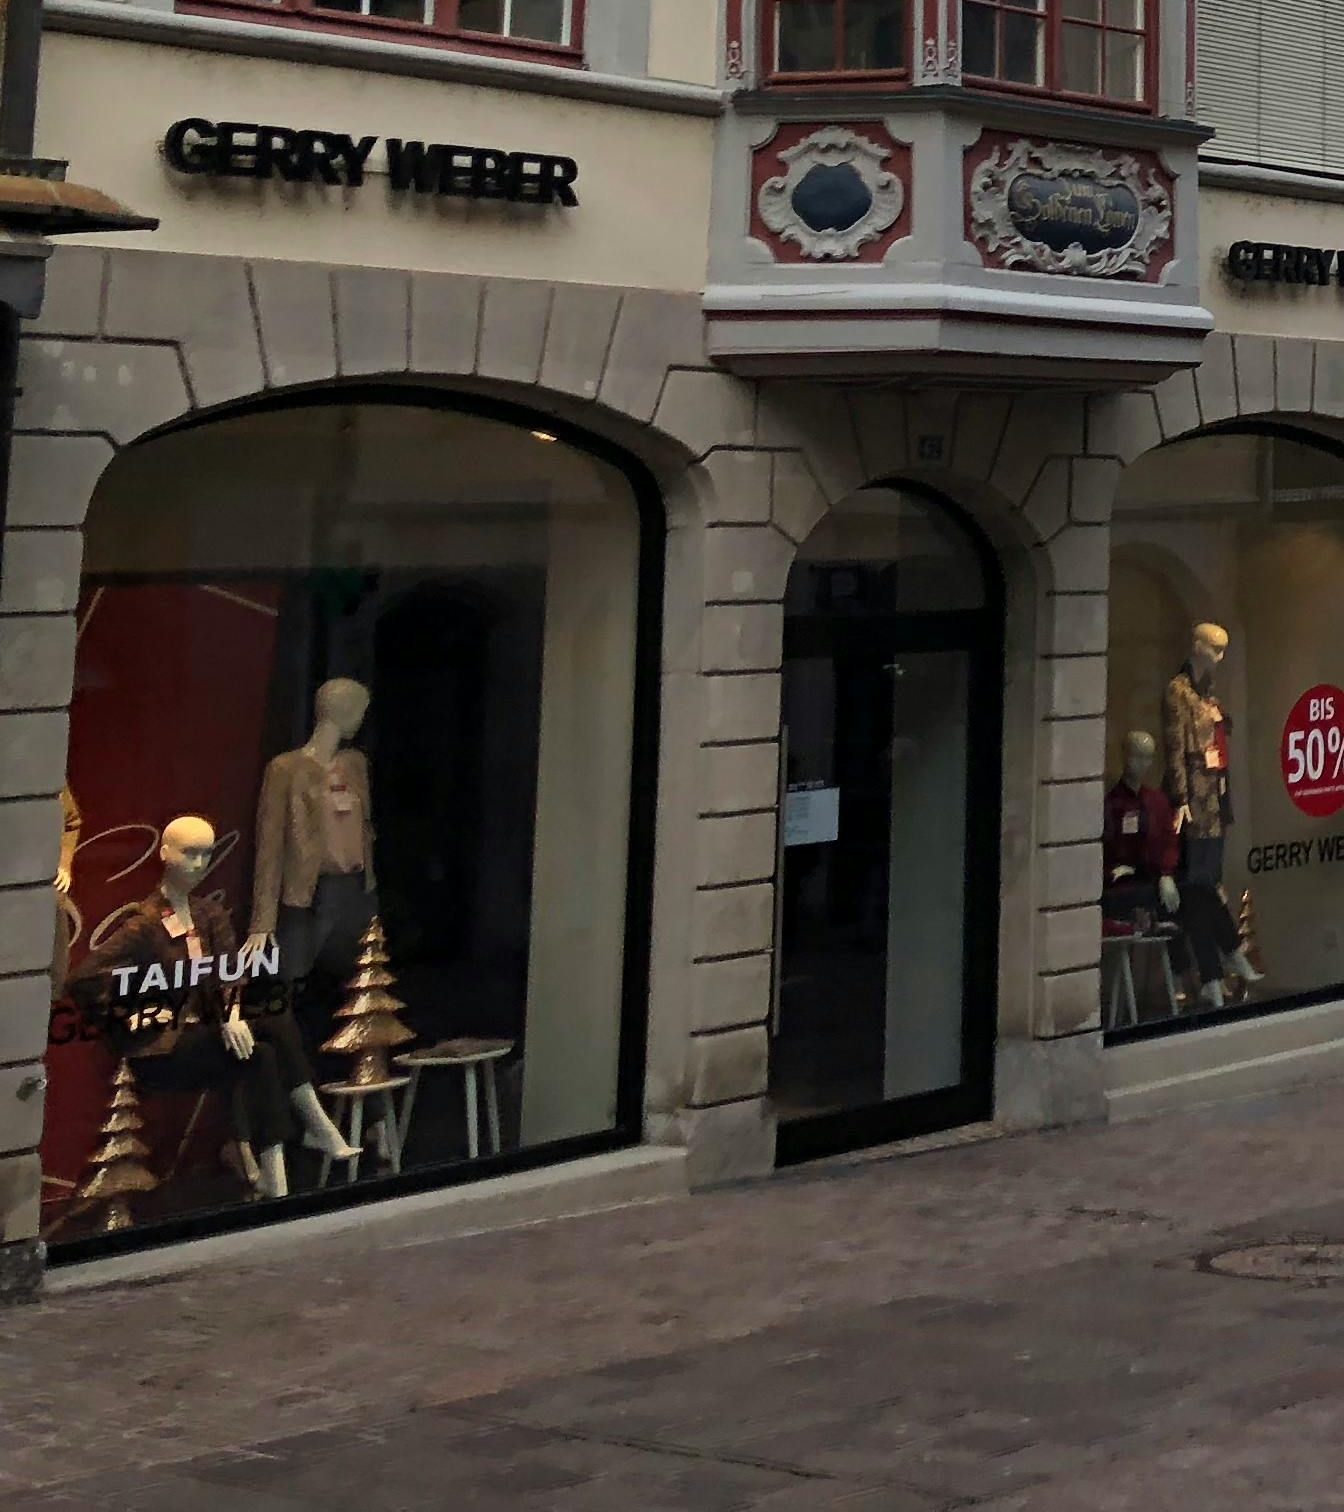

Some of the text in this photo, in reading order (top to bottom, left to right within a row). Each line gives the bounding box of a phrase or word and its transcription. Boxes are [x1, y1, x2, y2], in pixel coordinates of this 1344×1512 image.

[164, 118, 580, 208] GERRY WEBER
[1227, 239, 1333, 287] GERRY
[1308, 695, 1336, 723] BIS
[1247, 838, 1314, 874] GERRY
[110, 945, 281, 997] TAIFUN
